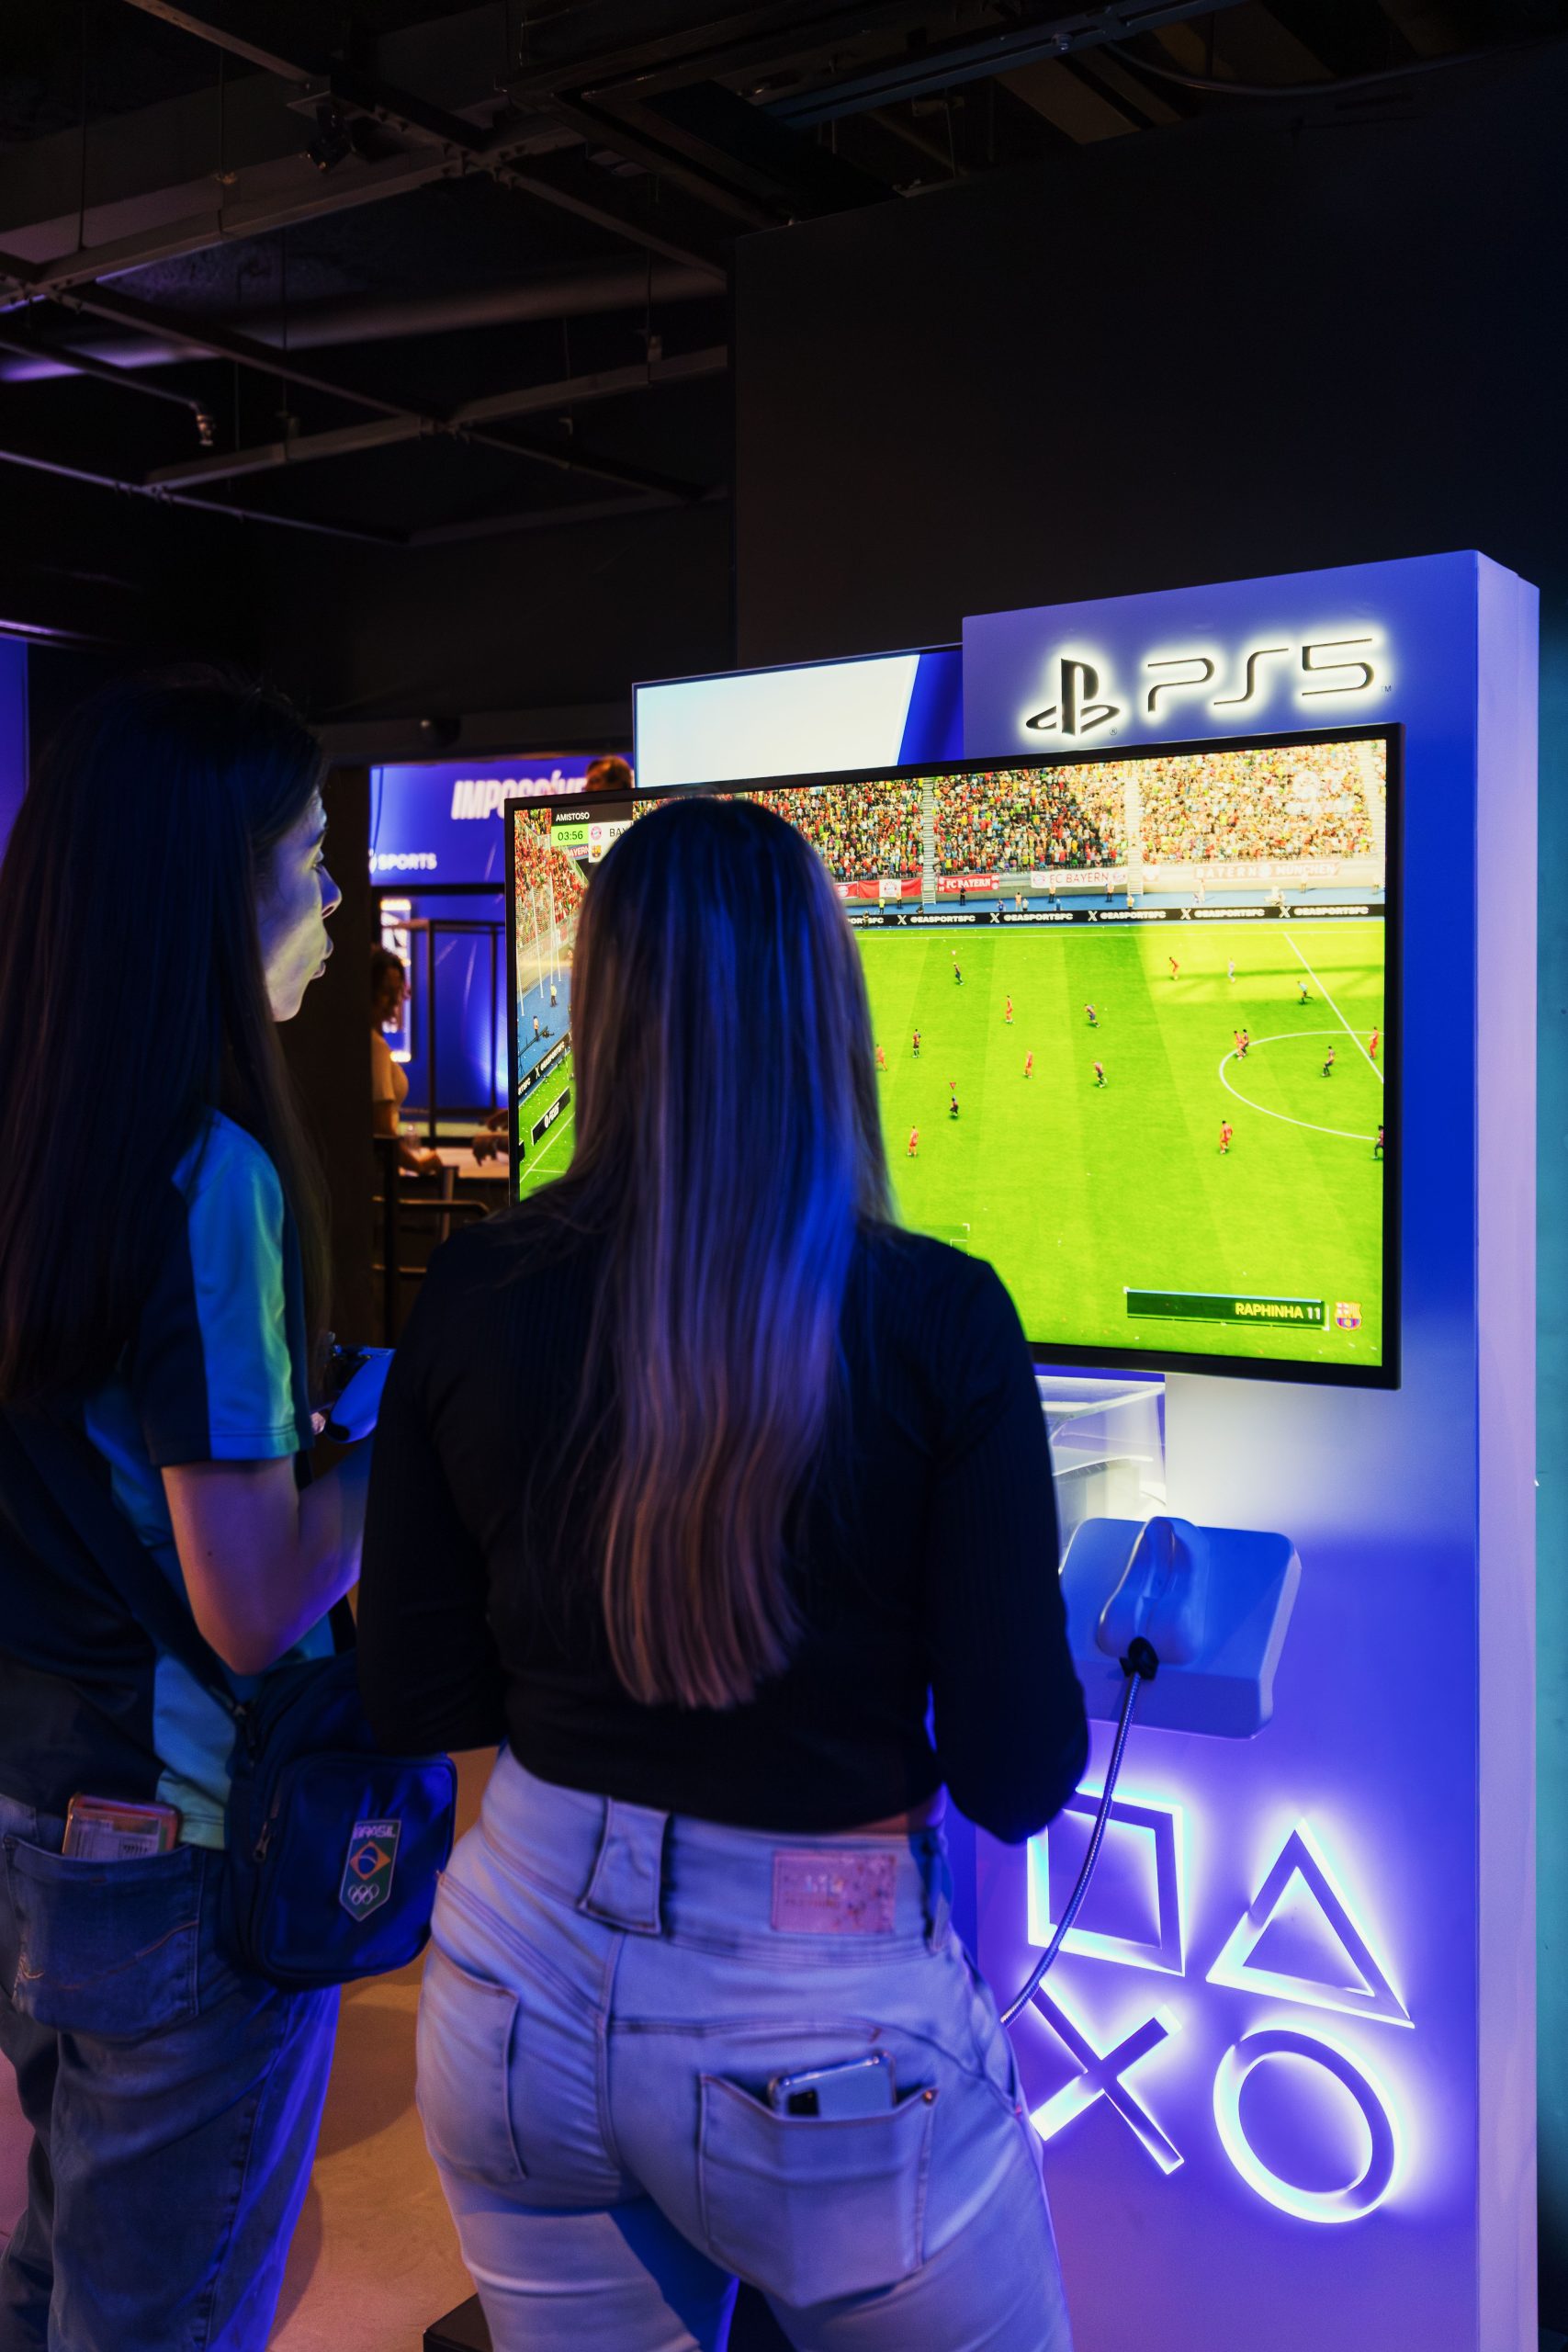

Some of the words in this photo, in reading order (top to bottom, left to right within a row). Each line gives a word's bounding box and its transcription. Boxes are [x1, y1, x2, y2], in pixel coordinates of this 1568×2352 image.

[1147, 638, 1375, 713] PS5
[555, 812, 590, 822] AMISTOSO
[557, 831, 583, 841] 03:56
[378, 852, 437, 871] SPORTS
[946, 879, 957, 888] FC
[958, 877, 991, 888] BAYERN
[1066, 873, 1109, 883] BAYERN
[1235, 1302, 1304, 1319] RAPHINHA
[1306, 1306, 1321, 1320] 11
